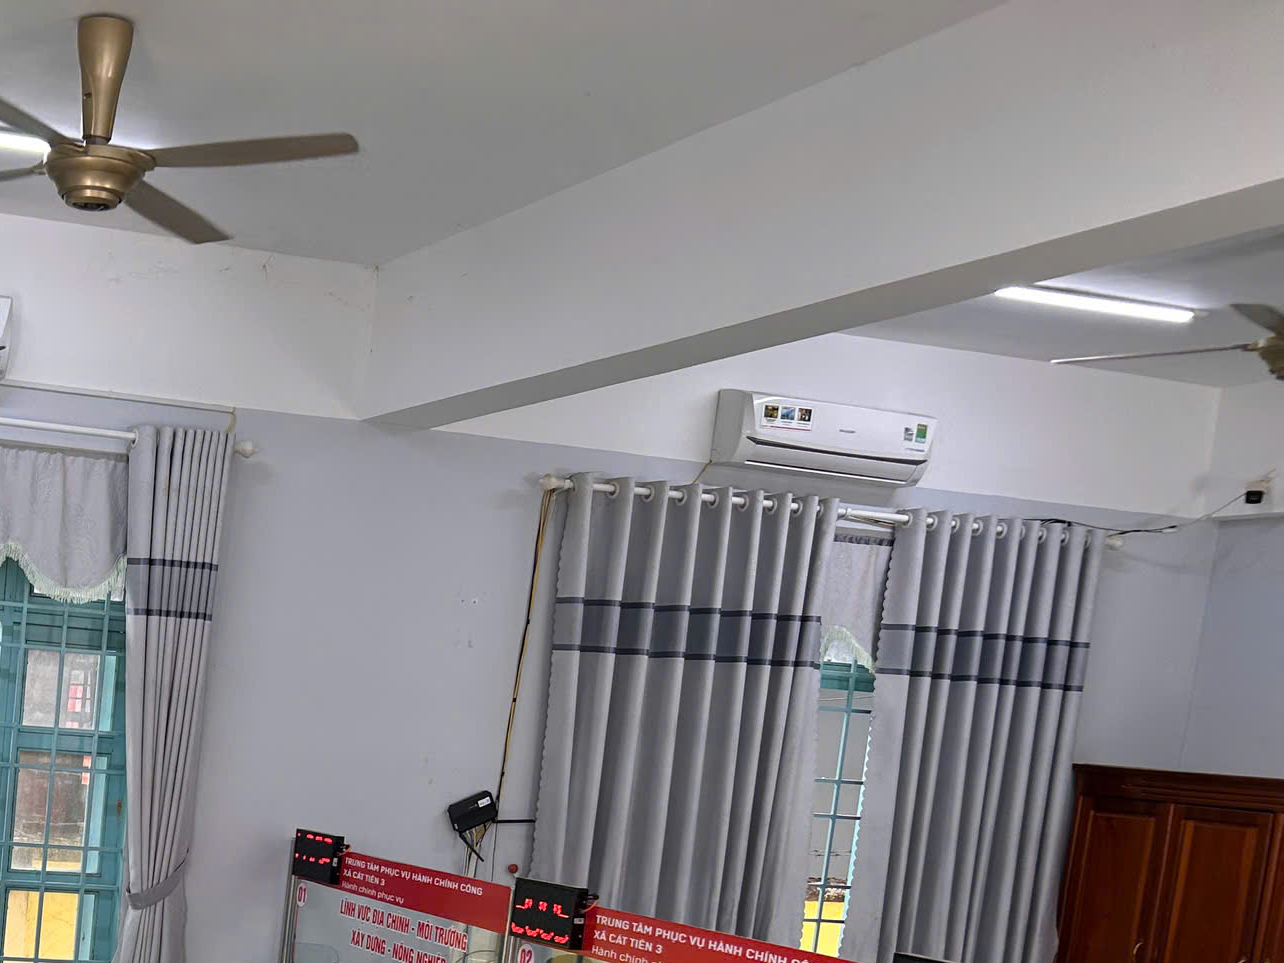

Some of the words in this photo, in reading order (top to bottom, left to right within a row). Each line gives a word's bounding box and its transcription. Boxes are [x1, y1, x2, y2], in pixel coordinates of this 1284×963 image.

[345, 857, 366, 869] TRUNG
[367, 862, 380, 872] TÂM
[380, 866, 400, 877] PHỤC
[401, 870, 411, 880] VỤ
[412, 872, 433, 884] HÀNH
[434, 877, 459, 890] CHÍNH
[460, 883, 483, 896] CÔNG
[380, 878, 386, 886] 3
[297, 886, 308, 903] 01
[341, 880, 358, 892] Hành
[358, 886, 377, 897] chính
[377, 891, 395, 902] phục
[395, 896, 405, 905] vụ
[593, 929, 606, 941] XÃ
[609, 933, 628, 946] CÁT
[629, 938, 653, 952] TIÊN
[655, 944, 663, 954] 3
[595, 914, 630, 930] TRUNG
[632, 922, 653, 935] TÂM
[655, 928, 687, 944] PHỤC
[689, 935, 706, 950] VỤ
[708, 940, 743, 957] HÀNH
[591, 944, 617, 960] Hành
